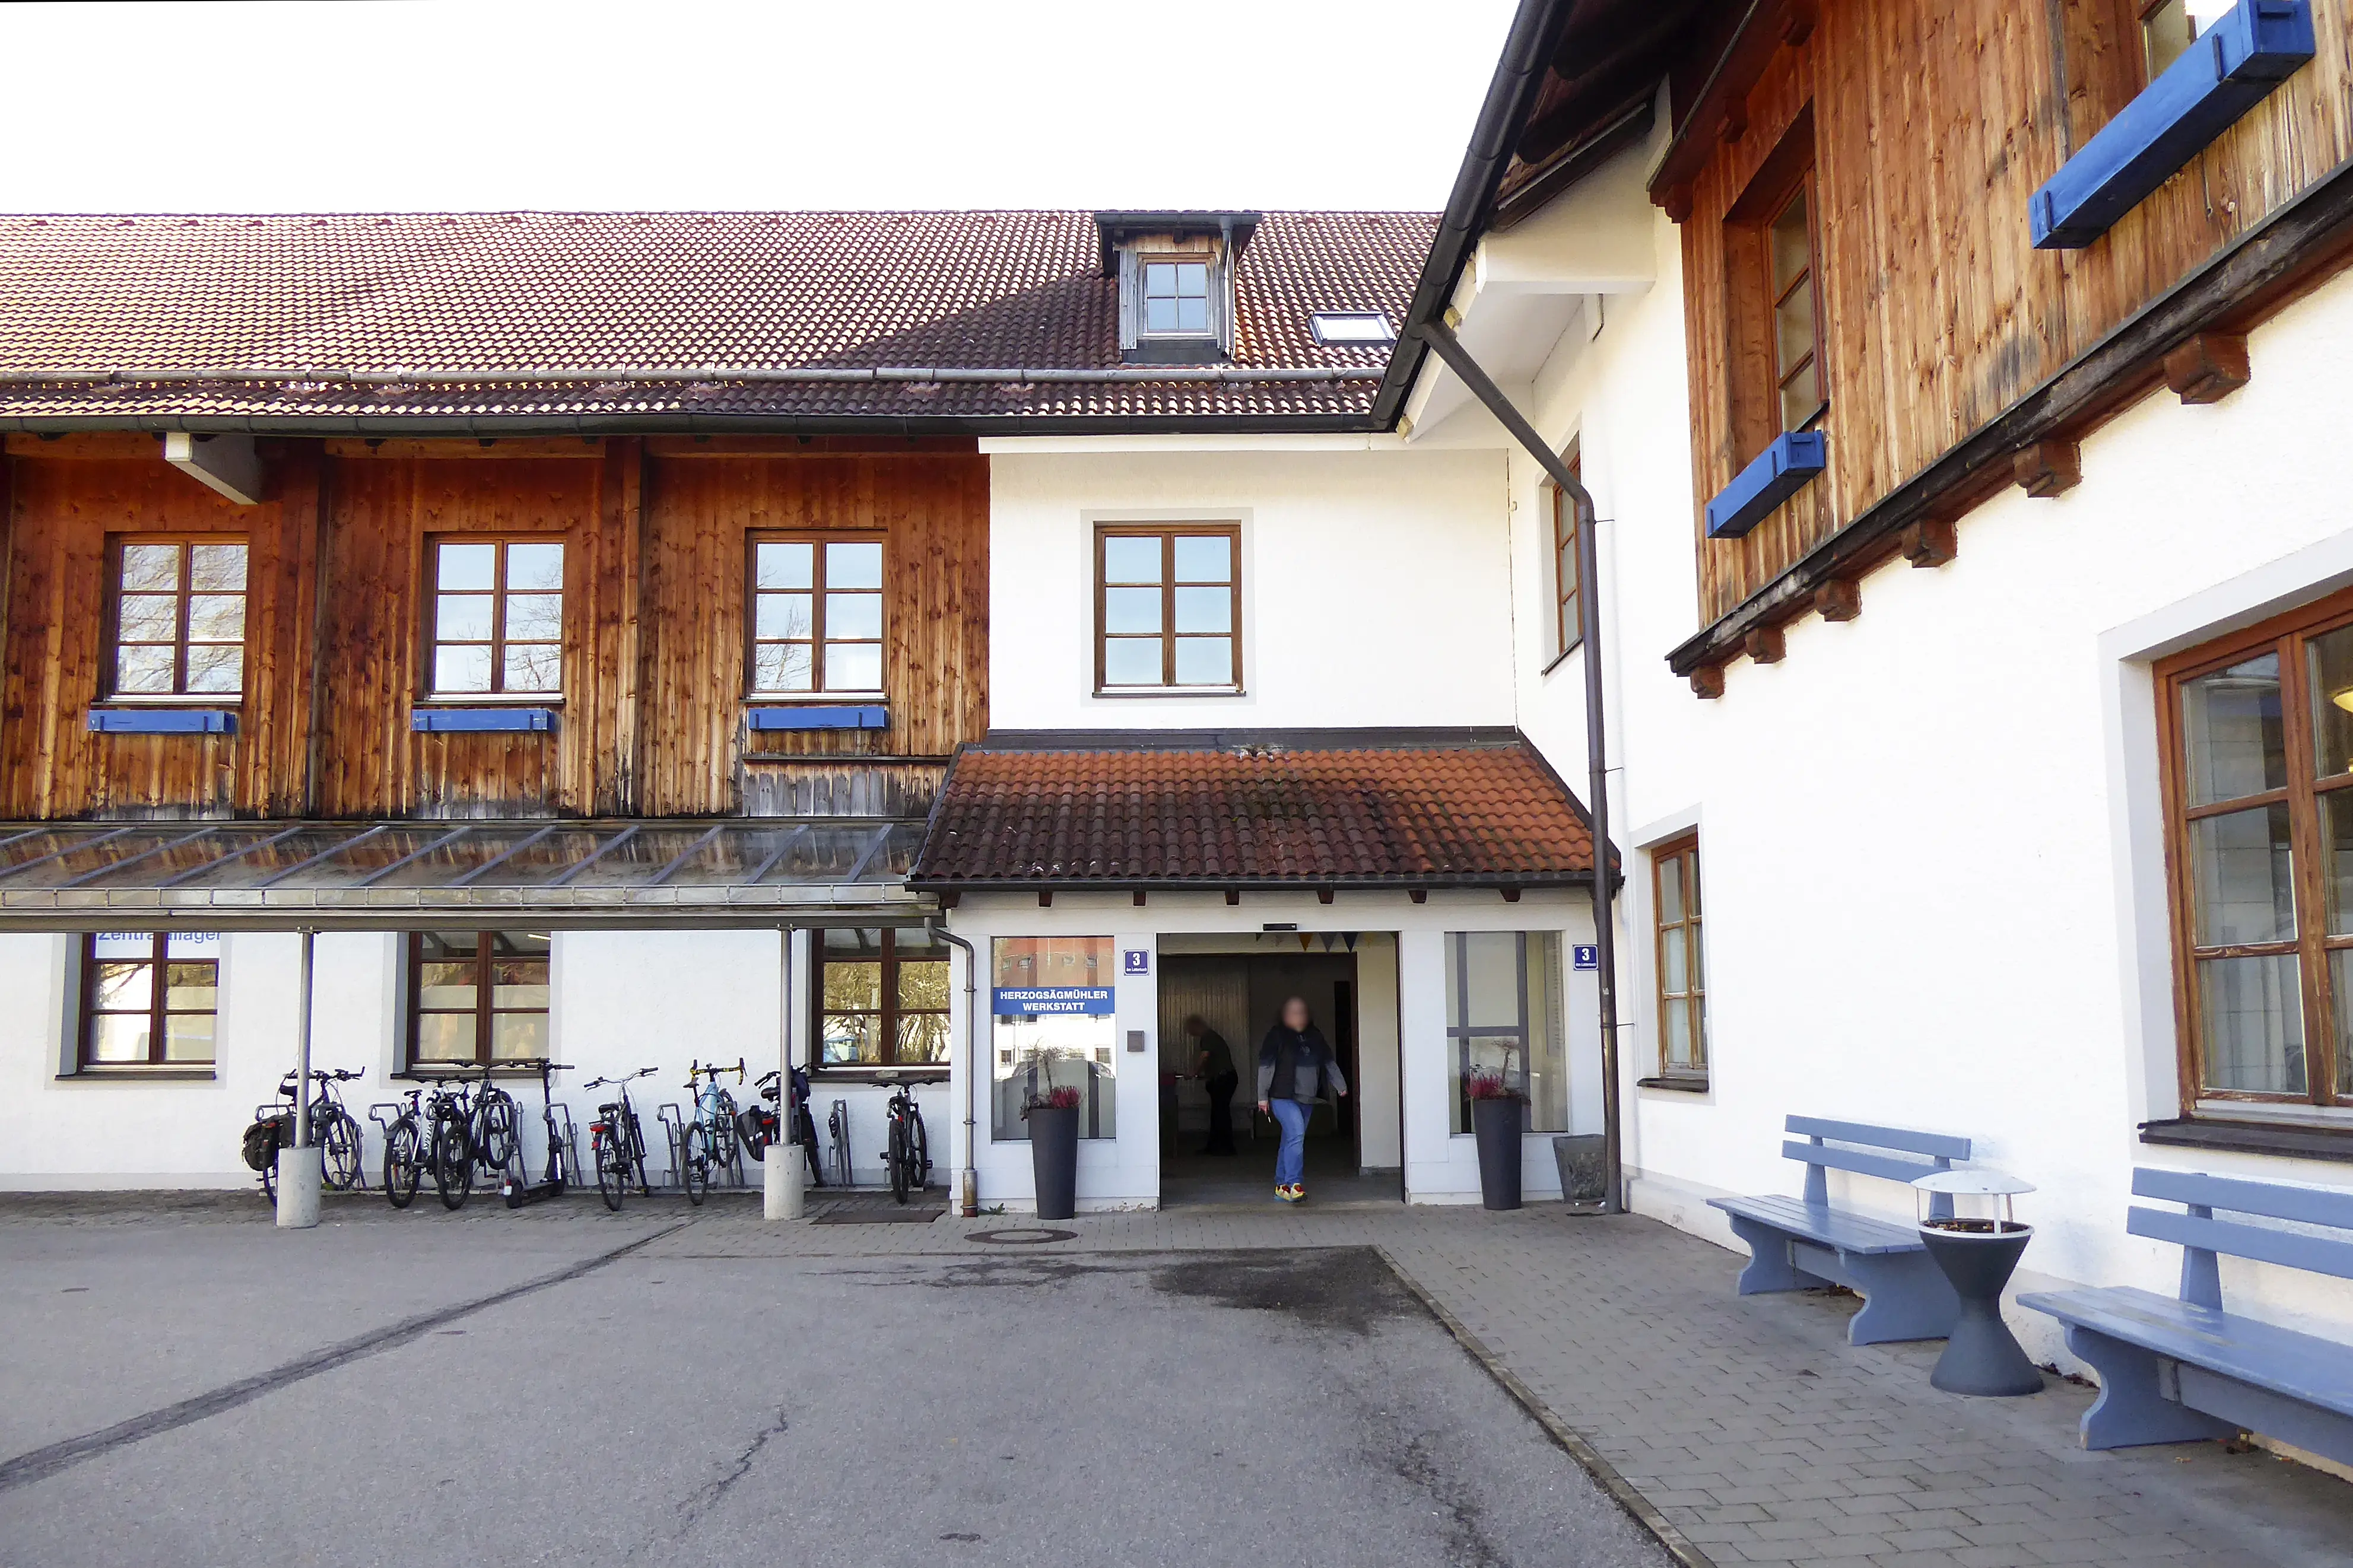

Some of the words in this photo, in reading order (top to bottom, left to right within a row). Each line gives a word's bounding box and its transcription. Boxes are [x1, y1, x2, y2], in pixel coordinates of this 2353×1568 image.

[1133, 953, 1140, 966] 3
[1582, 948, 1589, 960] 3
[1000, 989, 1108, 1000] HERZOGSÄGMÜHLER
[1023, 1002, 1085, 1011] WERKSTATT
